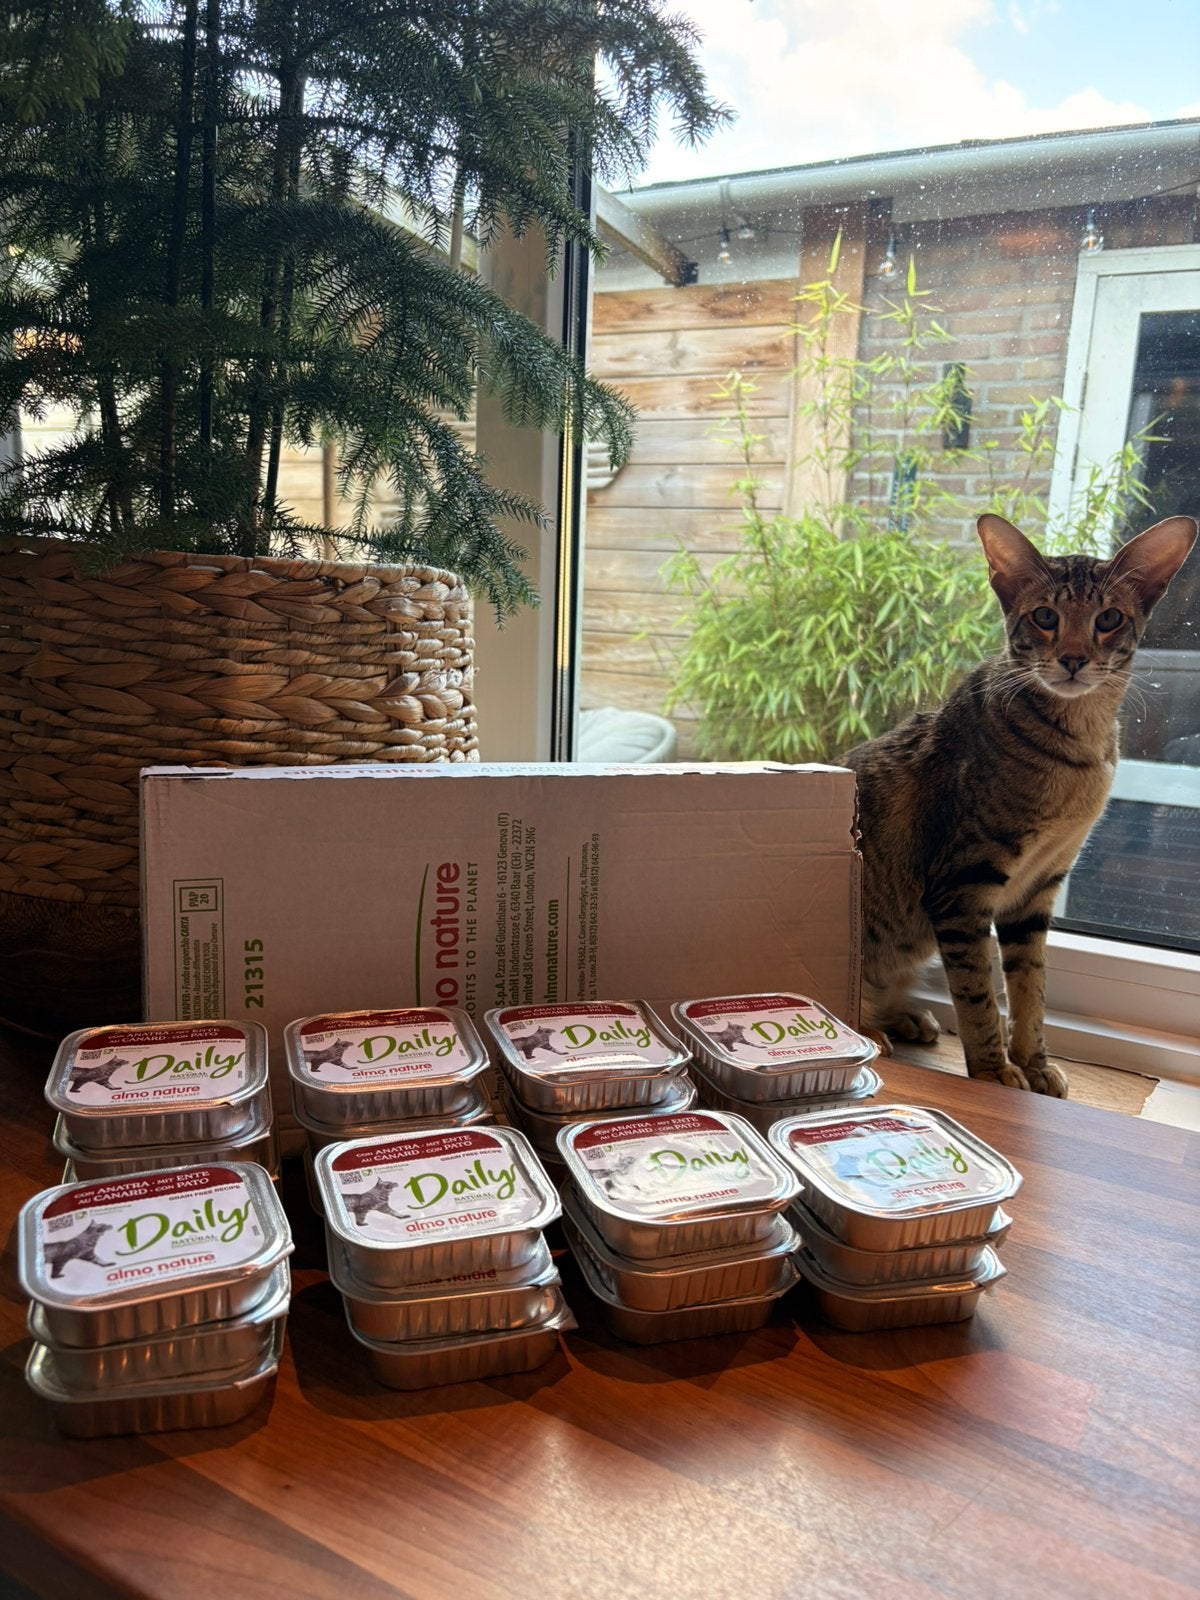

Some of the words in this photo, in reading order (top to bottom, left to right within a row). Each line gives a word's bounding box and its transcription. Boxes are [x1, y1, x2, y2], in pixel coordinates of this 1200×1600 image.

[498, 812, 510, 827] (IT)
[512, 819, 522, 845] 22372
[498, 829, 507, 859] Genova
[526, 827, 536, 844] 5NG
[511, 852, 522, 870] (CH)
[525, 845, 535, 870] WC2N
[497, 860, 507, 885] 16123
[511, 871, 520, 889] Baar
[189, 892, 198, 907] PAP
[200, 894, 208, 904] 20
[467, 862, 478, 912] PLANET
[524, 872, 536, 904] London,
[511, 891, 520, 911] 6340
[181, 916, 189, 936] CARTA
[431, 863, 460, 969] nature
[496, 900, 506, 943] Giustiniani
[524, 906, 535, 932] Street,
[467, 918, 477, 943] THE
[466, 950, 476, 967] TO
[496, 944, 505, 957] dei
[509, 922, 520, 977] Lindenstrasse
[523, 934, 533, 960] Craven
[245, 939, 263, 1008] 21315
[496, 958, 505, 978] P.zza
[523, 962, 533, 973] 38
[182, 993, 190, 1014] PAPER
[466, 973, 476, 1018] ROFITS
[495, 979, 507, 1006] S.p.A.
[509, 979, 519, 1006] GmbH
[560, 1020, 651, 1049] Daily
[750, 1013, 838, 1044] Daily
[357, 1029, 457, 1064] Daily
[124, 1046, 245, 1084] Daily
[352, 1069, 386, 1077] almo
[389, 1063, 432, 1073] nature
[111, 1090, 149, 1100] almo
[153, 1086, 200, 1096] nature
[611, 1122, 652, 1132] ANATRA
[670, 1116, 699, 1124] ENTE
[611, 1127, 653, 1138] CANARD
[374, 1149, 420, 1161] CANARD
[444, 1141, 472, 1150] PATO
[375, 1143, 420, 1155] ANATRA
[441, 1135, 472, 1144] ENTE
[648, 1140, 750, 1182] Daily
[867, 1138, 968, 1180] Daily
[74, 1191, 95, 1199] CON
[97, 1180, 150, 1194] ANATRA
[176, 1171, 210, 1181] ENTE
[93, 1188, 148, 1202] CANARD
[176, 1178, 209, 1188] PATO
[214, 1185, 240, 1193] RECIPE
[403, 1160, 516, 1210] Daily
[924, 1182, 966, 1194] nature
[115, 1199, 252, 1256] Daily
[406, 1219, 445, 1232] almo
[448, 1209, 497, 1225] nature
[106, 1266, 153, 1281] almo
[158, 1253, 215, 1270] nature
